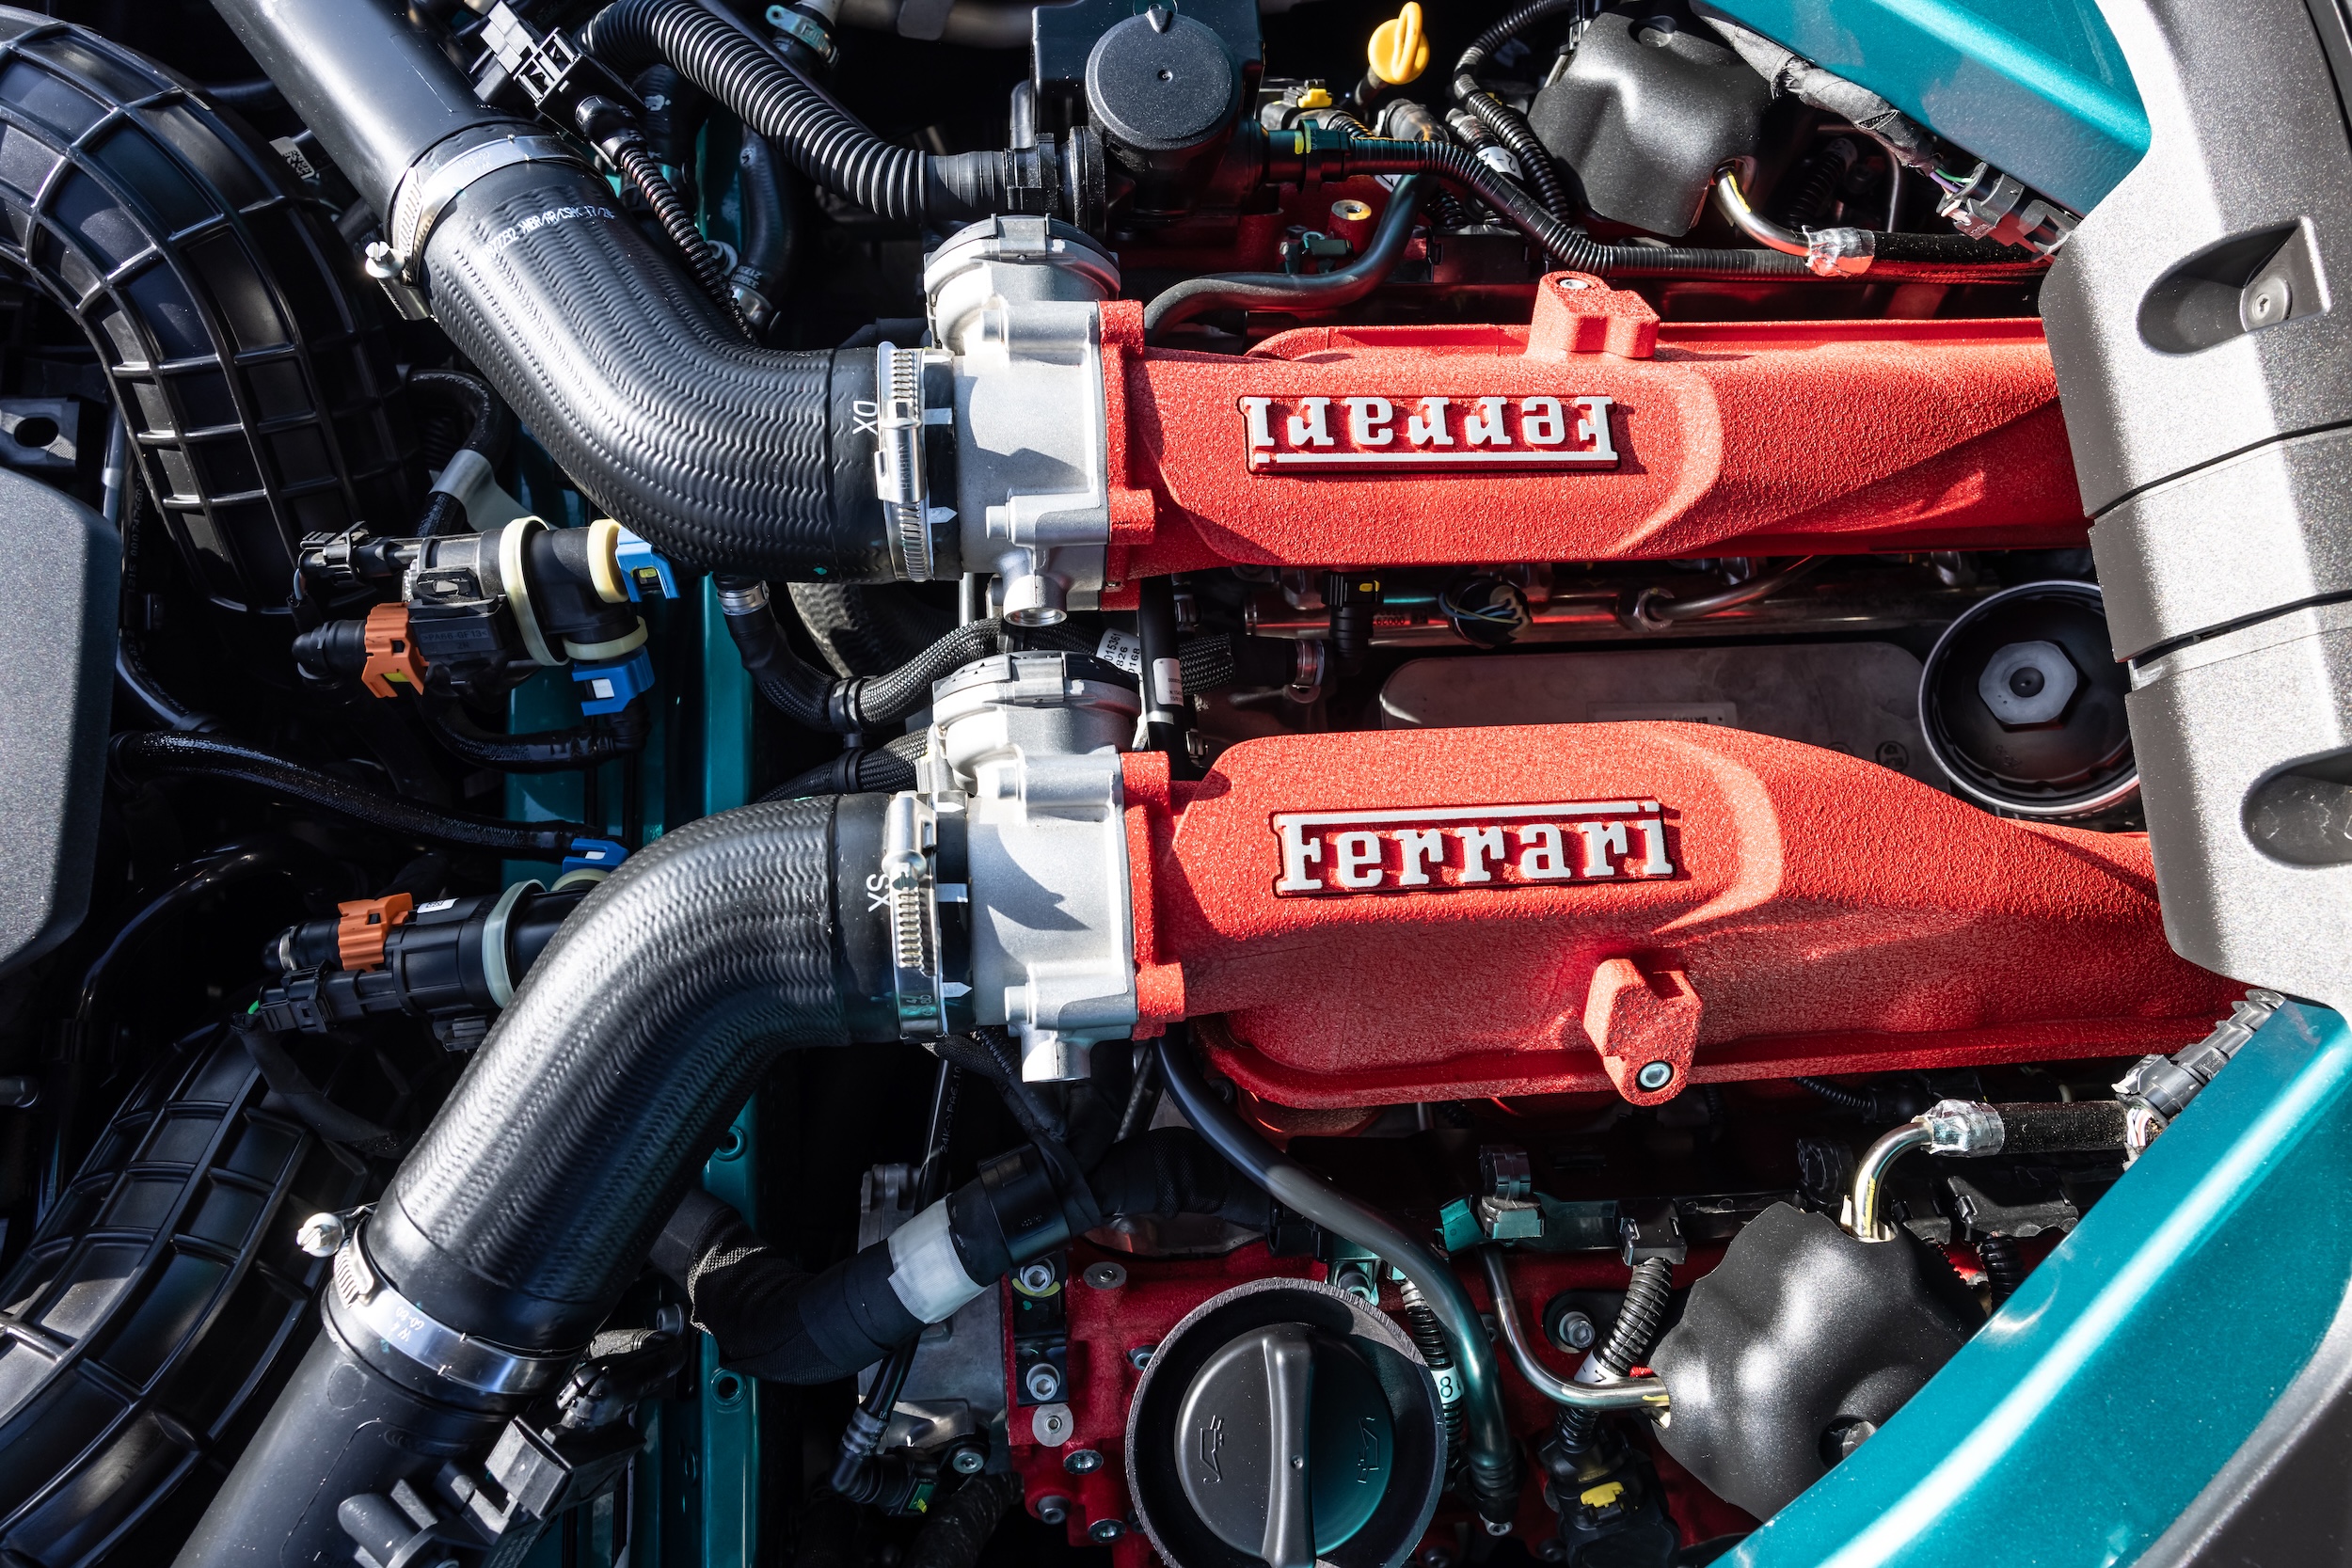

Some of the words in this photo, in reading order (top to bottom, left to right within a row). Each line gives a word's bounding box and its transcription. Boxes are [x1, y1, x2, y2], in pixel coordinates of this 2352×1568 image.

[852, 400, 878, 436] DX
[1246, 397, 1619, 463] Ferrari
[1278, 800, 1674, 892] Ferrari
[866, 873, 891, 912] SX
